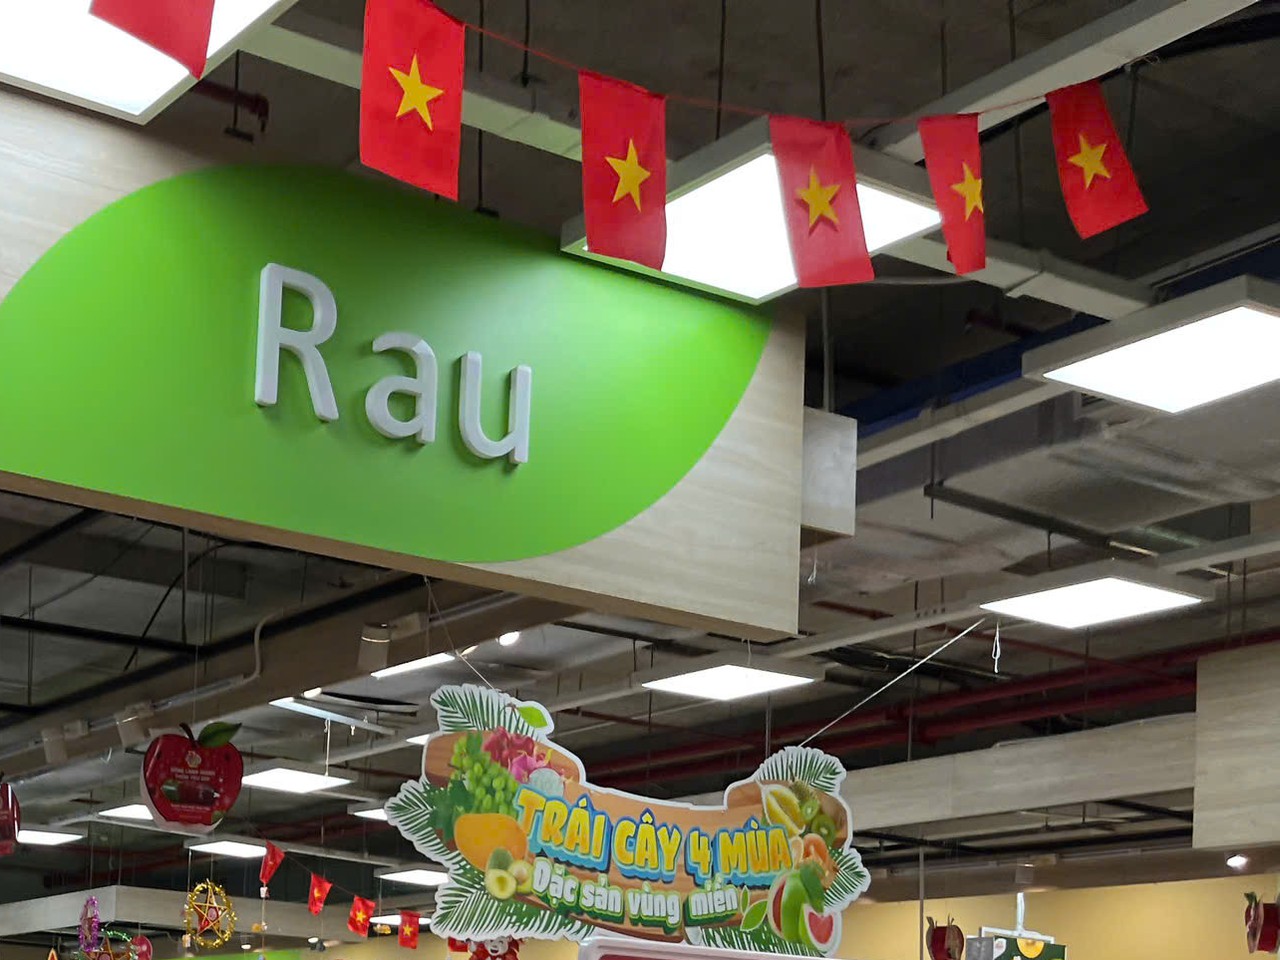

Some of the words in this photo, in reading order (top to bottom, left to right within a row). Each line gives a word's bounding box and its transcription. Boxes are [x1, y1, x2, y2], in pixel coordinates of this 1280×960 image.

[254, 263, 532, 464] Rau
[517, 788, 607, 859] TRÁI
[613, 811, 682, 872] CÂY
[688, 830, 713, 874] 4
[718, 819, 793, 874] MÙA
[581, 877, 622, 914] sản
[628, 882, 681, 926] vùng
[690, 876, 738, 918] miền
